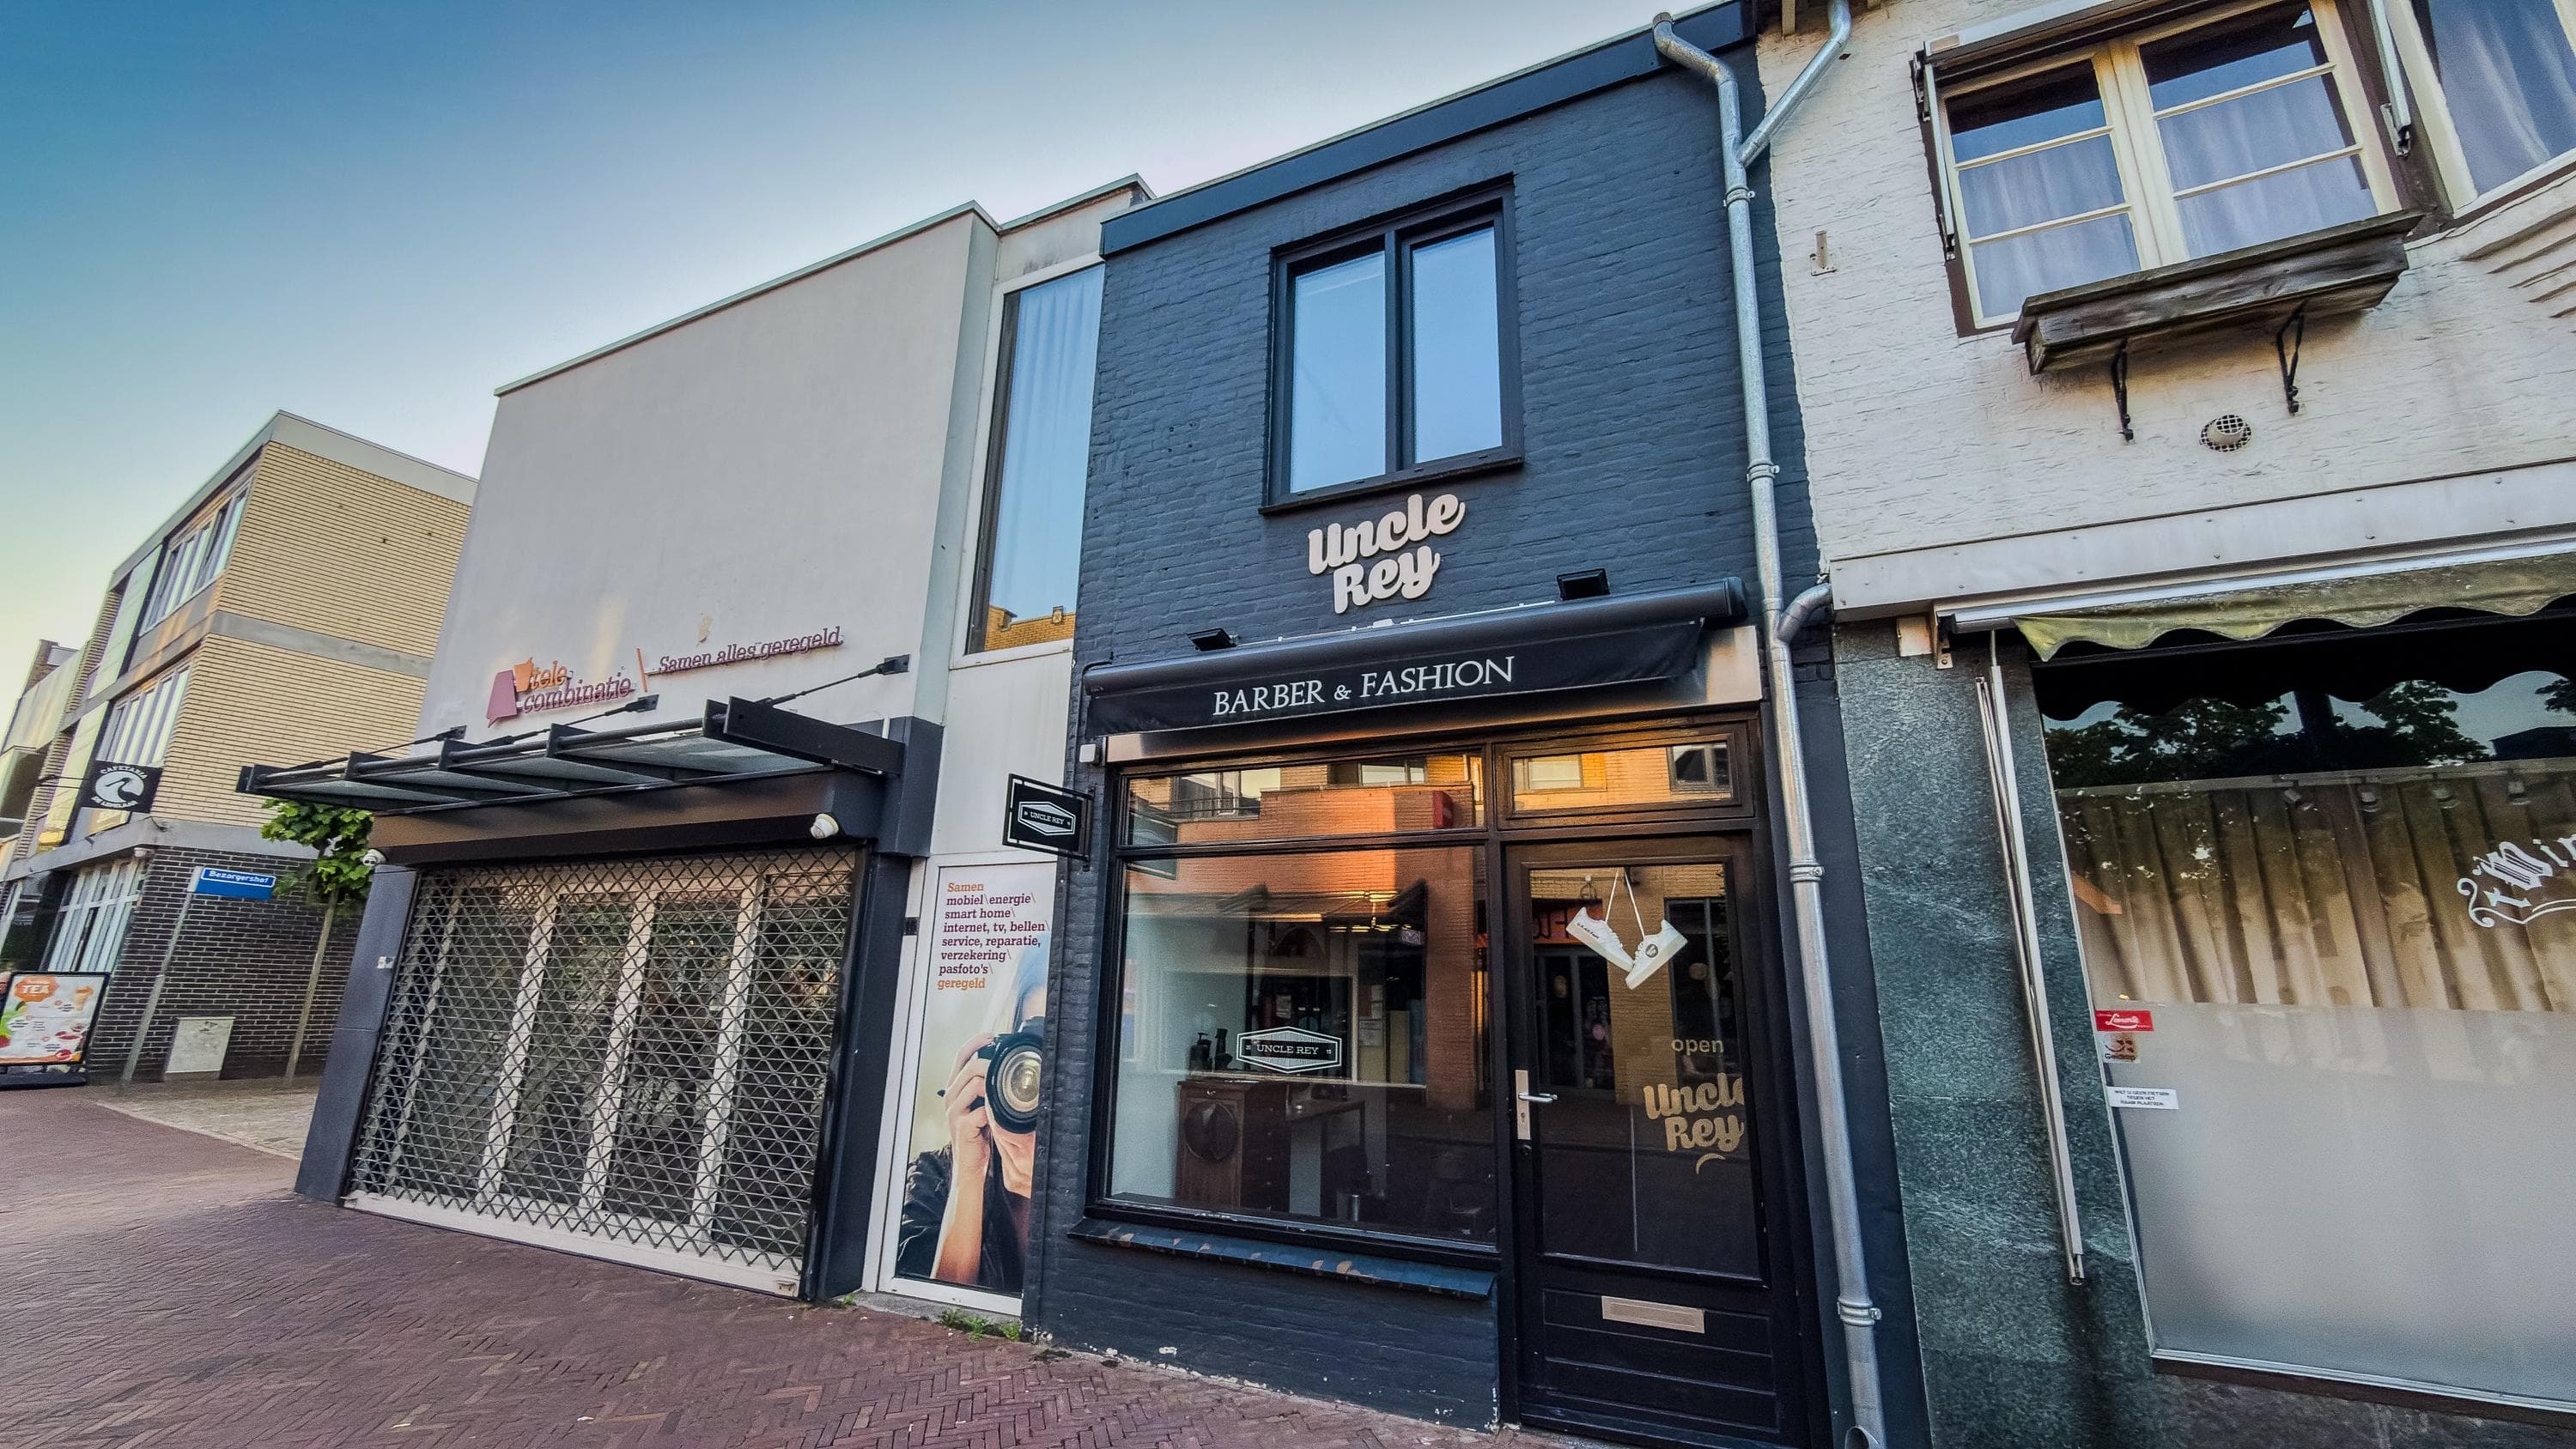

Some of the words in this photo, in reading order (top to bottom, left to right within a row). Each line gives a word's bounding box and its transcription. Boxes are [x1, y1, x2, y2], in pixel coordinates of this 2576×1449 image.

[1308, 494, 1466, 575] Uncle
[1333, 545, 1441, 614] Rey
[659, 655, 712, 673] Samen
[716, 644, 756, 662] alles
[522, 671, 635, 713] combinatie
[1212, 680, 1325, 716] BARBER
[1334, 685, 1352, 700] &
[1360, 656, 1515, 698] FASHION
[1030, 811, 1052, 822] UNCLE
[1052, 816, 1065, 825] REY
[209, 870, 269, 883] Bezorgershof
[947, 882, 984, 892] Samen
[945, 909, 976, 919] smart
[943, 923, 990, 934] internet,
[993, 923, 1006, 934] tv,
[942, 936, 983, 948] service,
[986, 935, 1041, 949] reparatie,
[938, 978, 986, 991] geregeld
[1257, 1044, 1294, 1054] UNCLE
[1296, 1046, 1319, 1055] REY
[1671, 1039, 1724, 1056] open
[1664, 1114, 1745, 1151] Rey
